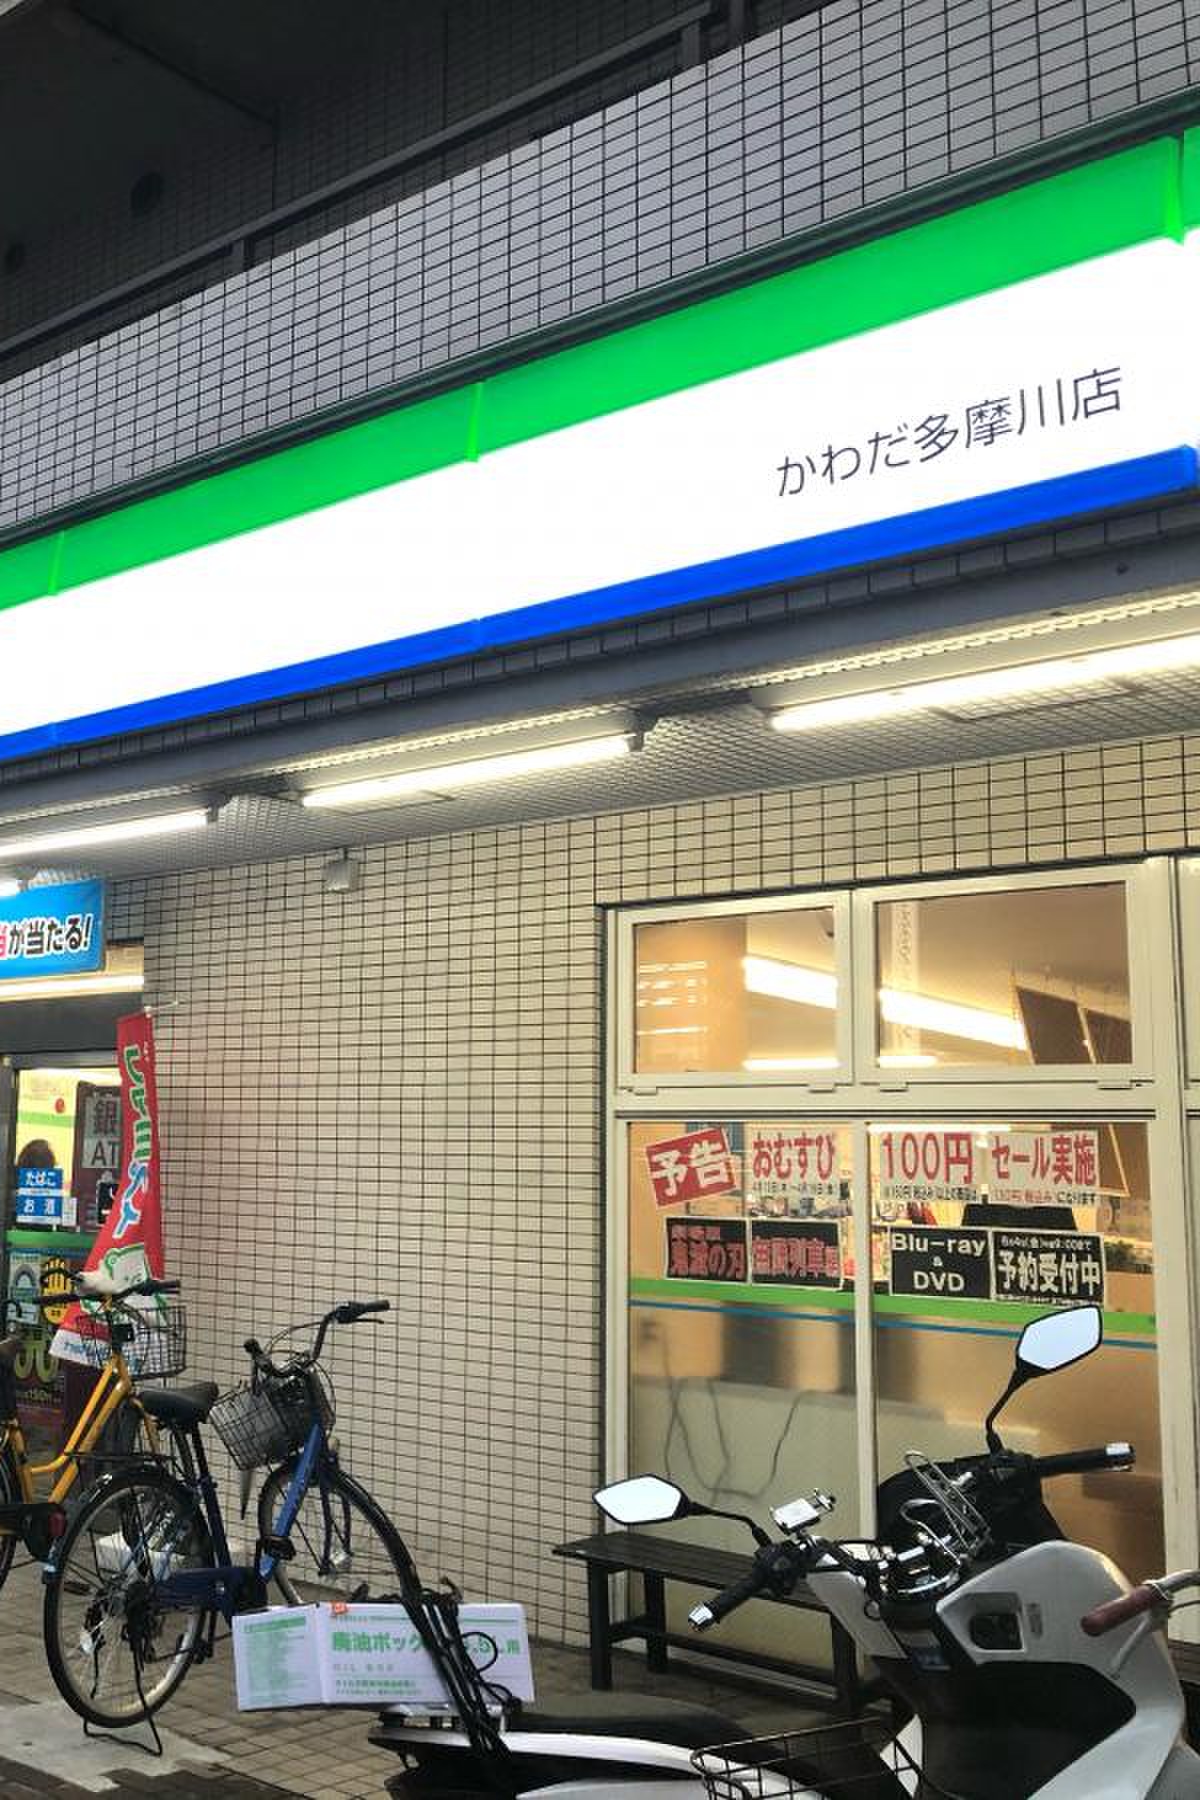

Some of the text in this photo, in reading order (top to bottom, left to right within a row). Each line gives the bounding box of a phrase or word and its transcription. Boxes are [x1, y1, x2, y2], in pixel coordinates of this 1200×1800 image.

[777, 366, 1122, 497] かわだ多摩川店
[91, 1141, 121, 1167] AT
[752, 1131, 1097, 1187] おむすび 100円 セール実施
[25, 1170, 57, 1187] たばこ
[652, 1140, 730, 1197] 予告
[892, 1233, 985, 1257] Blu-ray
[933, 1257, 943, 1267] &
[998, 1250, 1100, 1296] 予約受付中
[913, 1271, 965, 1292] DVD
